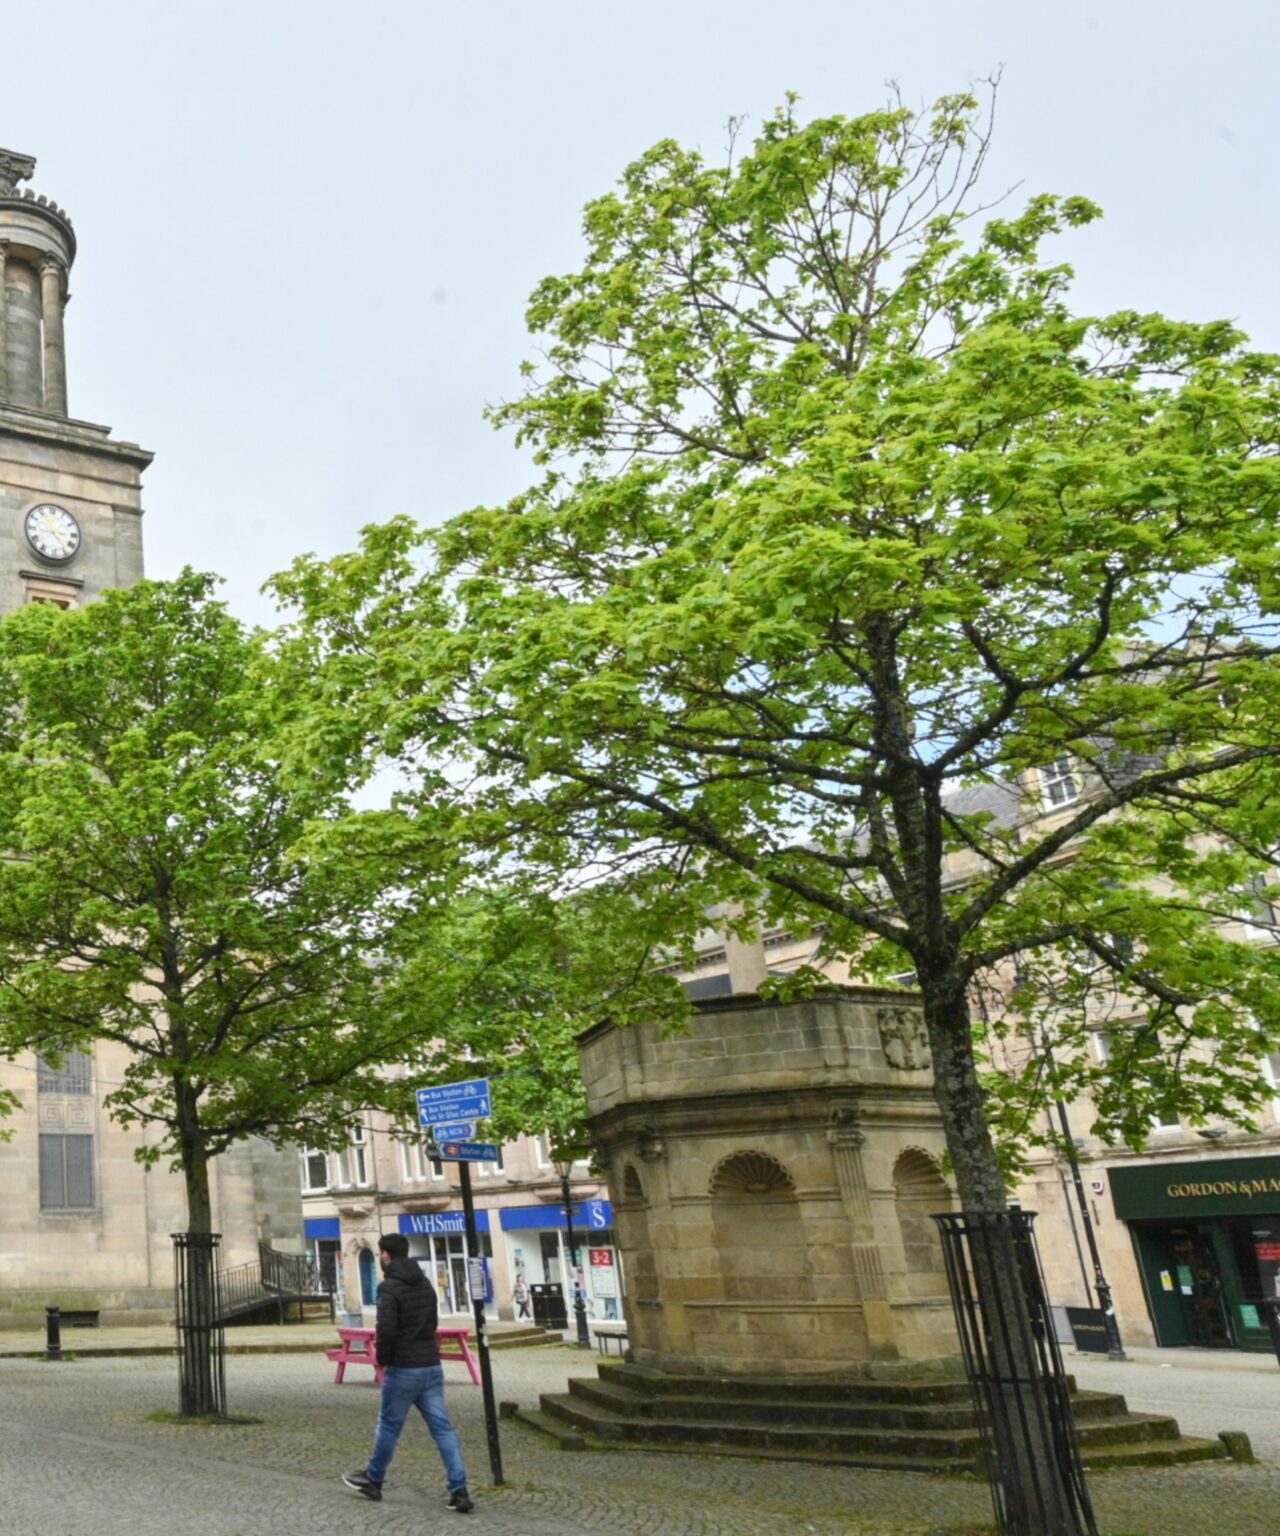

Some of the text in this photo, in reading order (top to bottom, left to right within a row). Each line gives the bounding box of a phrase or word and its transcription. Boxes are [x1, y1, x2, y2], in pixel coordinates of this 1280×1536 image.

[439, 1104, 460, 1112] Station
[461, 1147, 481, 1155] Station
[1166, 1178, 1280, 1200] GORDON & MA
[410, 1212, 466, 1234] WHSmit
[592, 1206, 606, 1229] S
